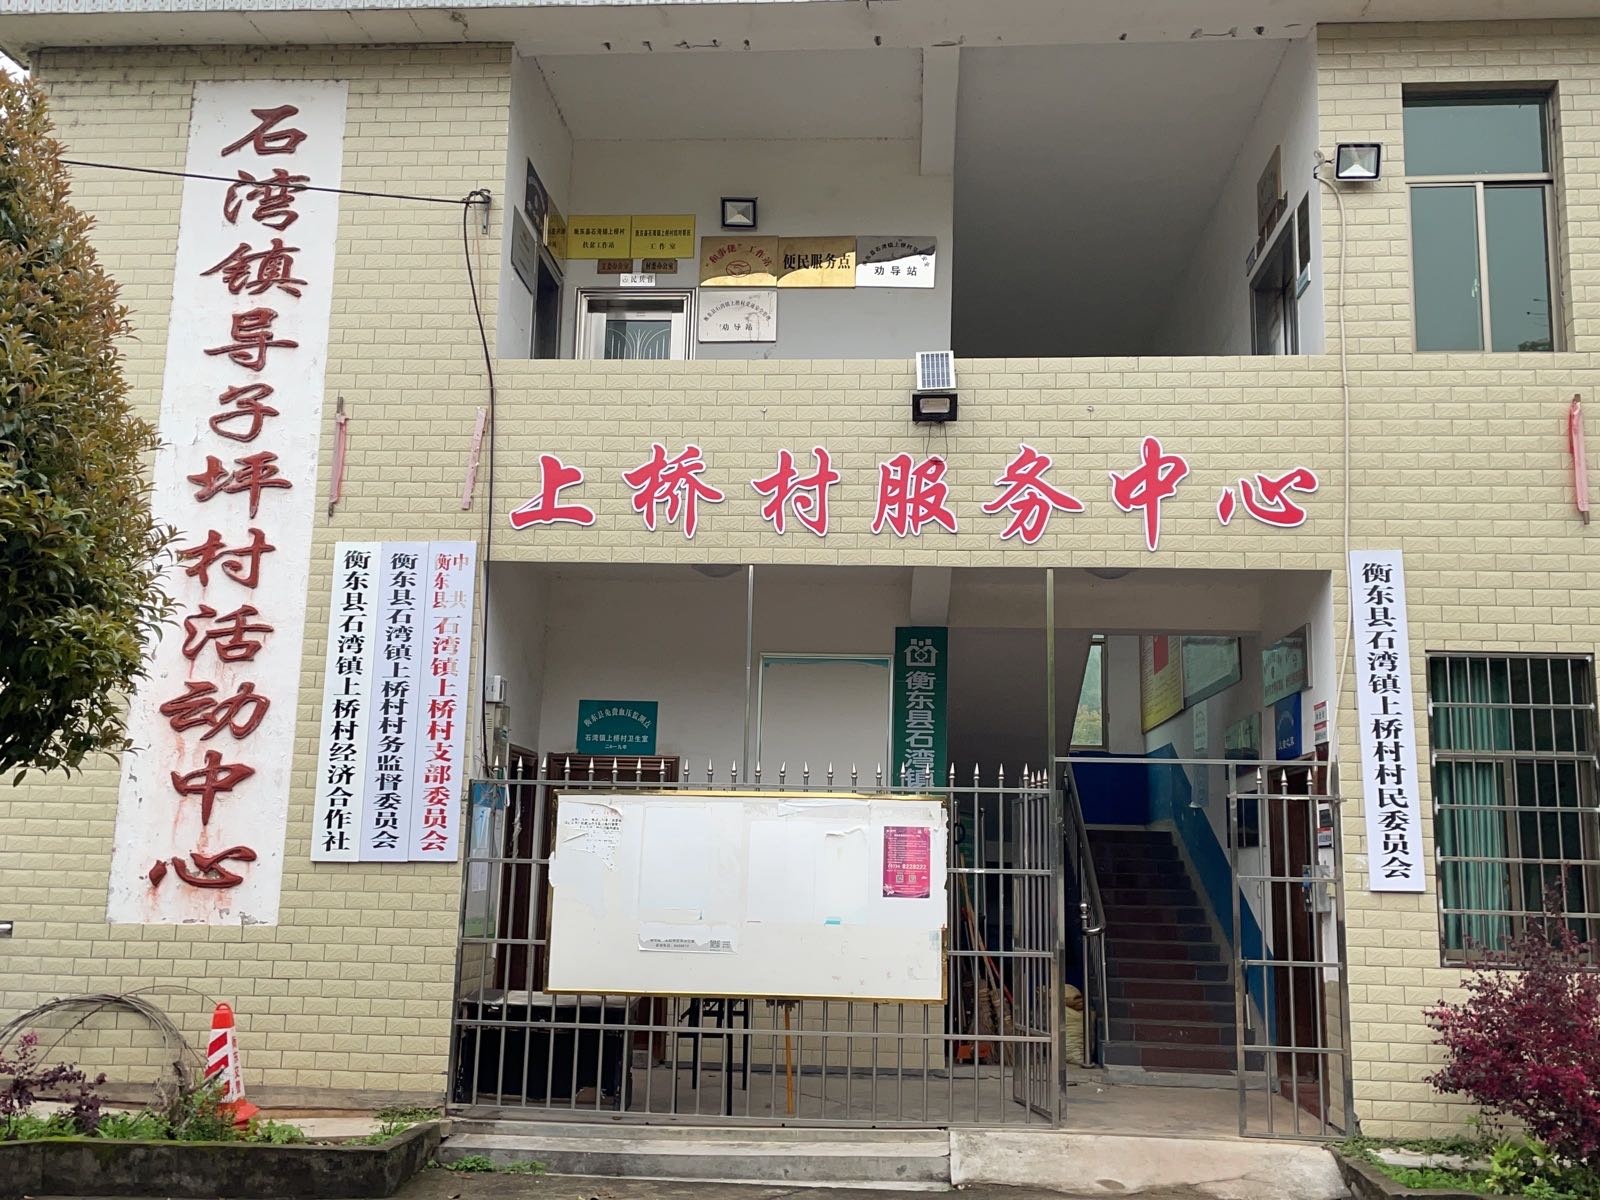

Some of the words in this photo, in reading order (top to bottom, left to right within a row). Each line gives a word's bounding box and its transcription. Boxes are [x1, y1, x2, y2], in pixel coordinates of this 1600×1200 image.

[783, 252, 851, 270] 便民服务点
[874, 265, 918, 277] 劝导站
[149, 104, 310, 888] 石湾镇导子坪村活动中心
[509, 436, 1319, 551] 上桥村服务中心
[321, 550, 372, 852] 衡东县石湾镇上桥村经济合作社
[370, 552, 419, 850] 衡东县石湾镇上桥村村务监督委员会
[584, 707, 652, 729] 衡东县免费血压监测点
[584, 734, 649, 743] 石湾镇上桥村卫生室
[1361, 562, 1414, 880] 衡东县石湾镇上桥村村民委员会
